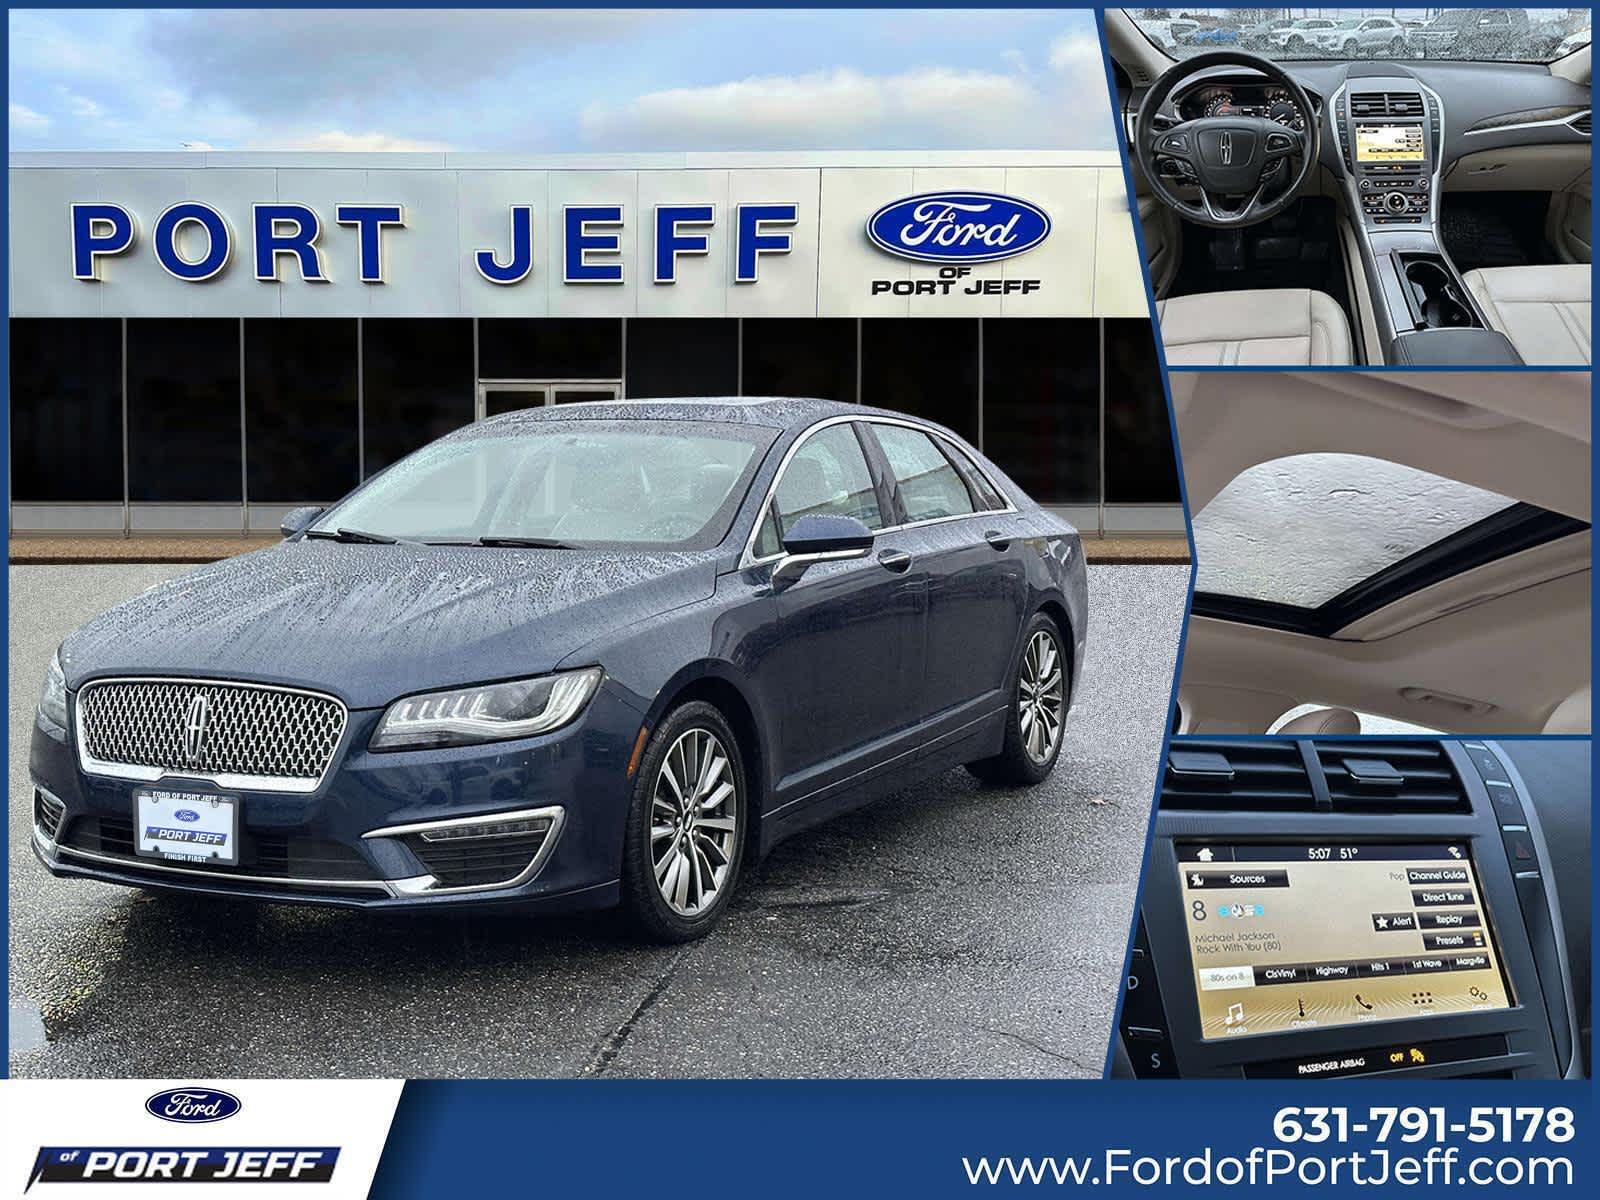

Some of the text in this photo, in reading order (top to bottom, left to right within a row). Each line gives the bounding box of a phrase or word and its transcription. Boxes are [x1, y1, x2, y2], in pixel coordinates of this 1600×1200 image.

[900, 201, 1021, 246] Ford
[70, 202, 800, 285] PORT JEFF
[939, 267, 971, 279] OF
[872, 280, 1041, 295] PORT JEFF
[152, 791, 218, 802] FORD OF PORT JEFF
[158, 829, 192, 841] PORT
[192, 833, 223, 844] JEFF
[187, 855, 207, 863] FIRST
[1308, 847, 1358, 860] 5:07 51°
[1229, 874, 1266, 884] Sources
[1409, 871, 1466, 880] Channel Guide
[1422, 892, 1465, 902] Direct Tune
[1192, 900, 1207, 921] 8
[1392, 916, 1412, 927] Alert
[1435, 915, 1463, 925] Replay
[1195, 931, 1276, 943] Michael Jackson
[1435, 935, 1464, 945] Presets
[1197, 944, 1221, 954] Rock
[1222, 943, 1243, 953] With
[1245, 943, 1262, 952] You
[1371, 963, 1384, 972] Hits
[1412, 960, 1443, 970] 1st Wave
[1315, 965, 1349, 977] Highway
[1127, 975, 1139, 991] D
[1226, 1026, 1248, 1035] Audio
[1151, 1053, 1161, 1069] S
[1390, 1053, 1404, 1063] OFF
[1298, 1058, 1366, 1074] PASSENGER AIRBAG
